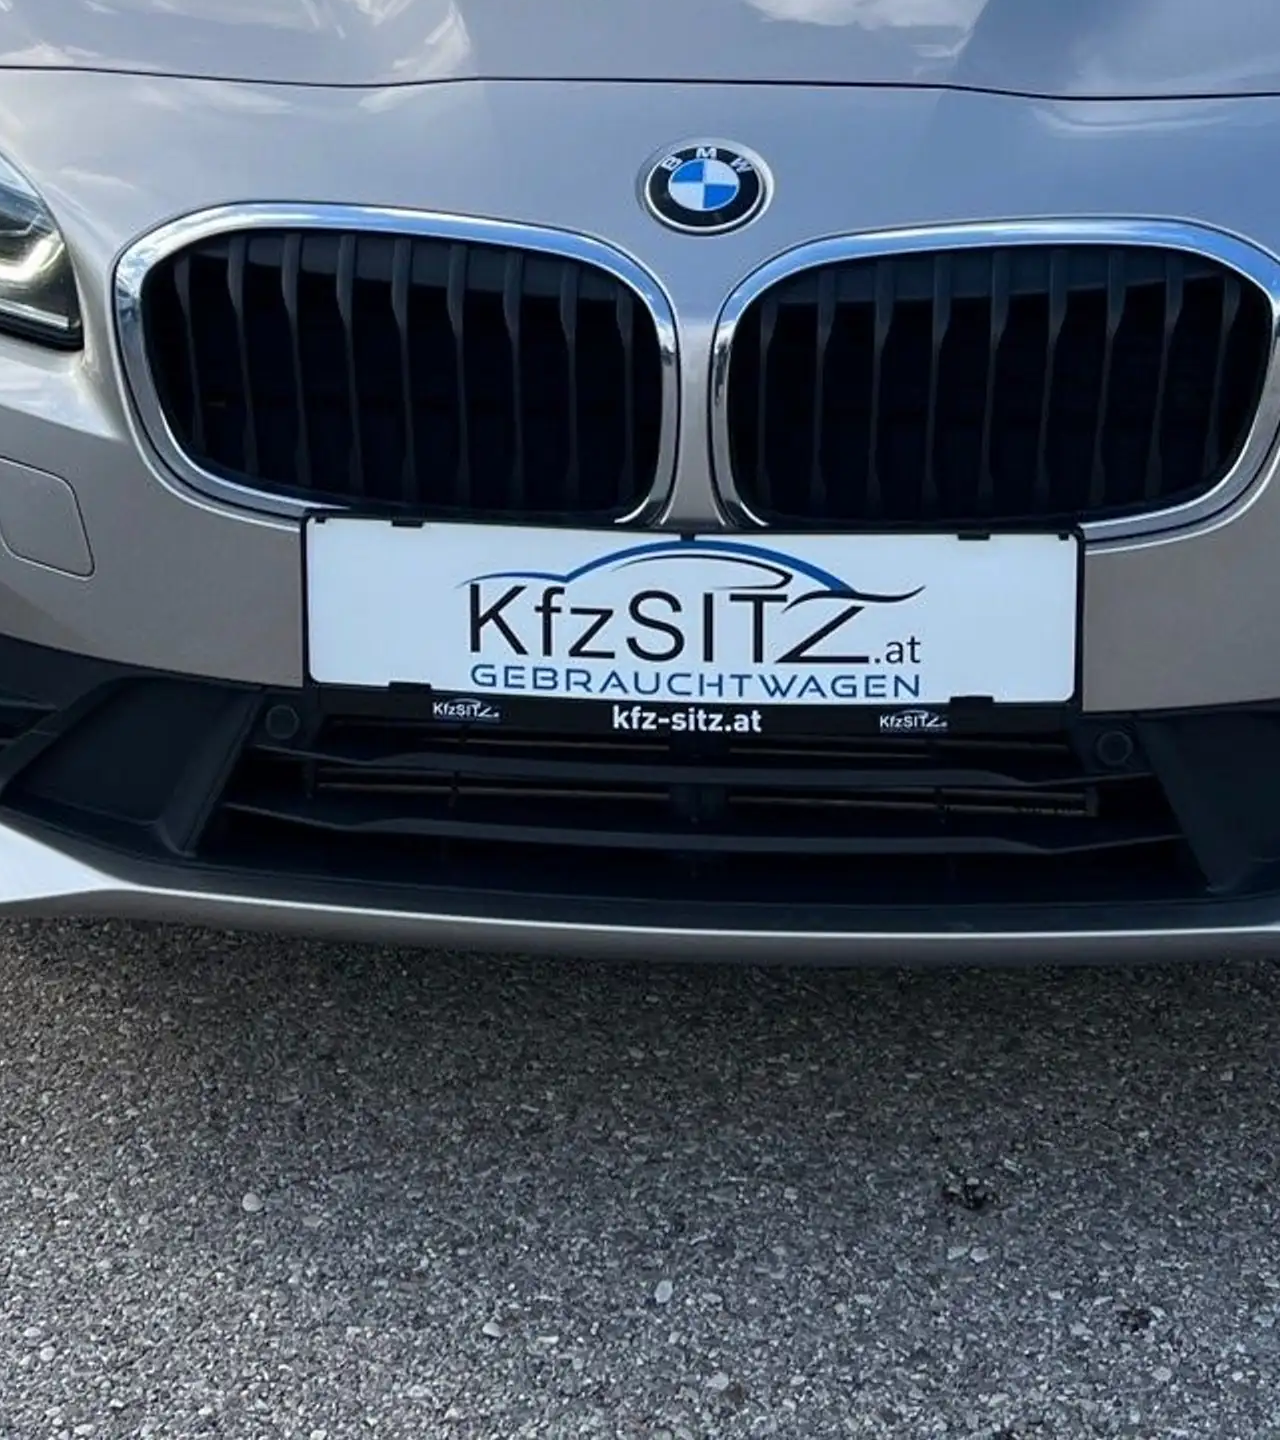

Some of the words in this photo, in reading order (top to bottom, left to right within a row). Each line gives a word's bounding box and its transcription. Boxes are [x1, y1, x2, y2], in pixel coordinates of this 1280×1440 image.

[661, 146, 754, 174] BMW
[470, 663, 921, 699] GEBRAUCHTWAGEN
[611, 704, 763, 733] kfz-sitz.at
